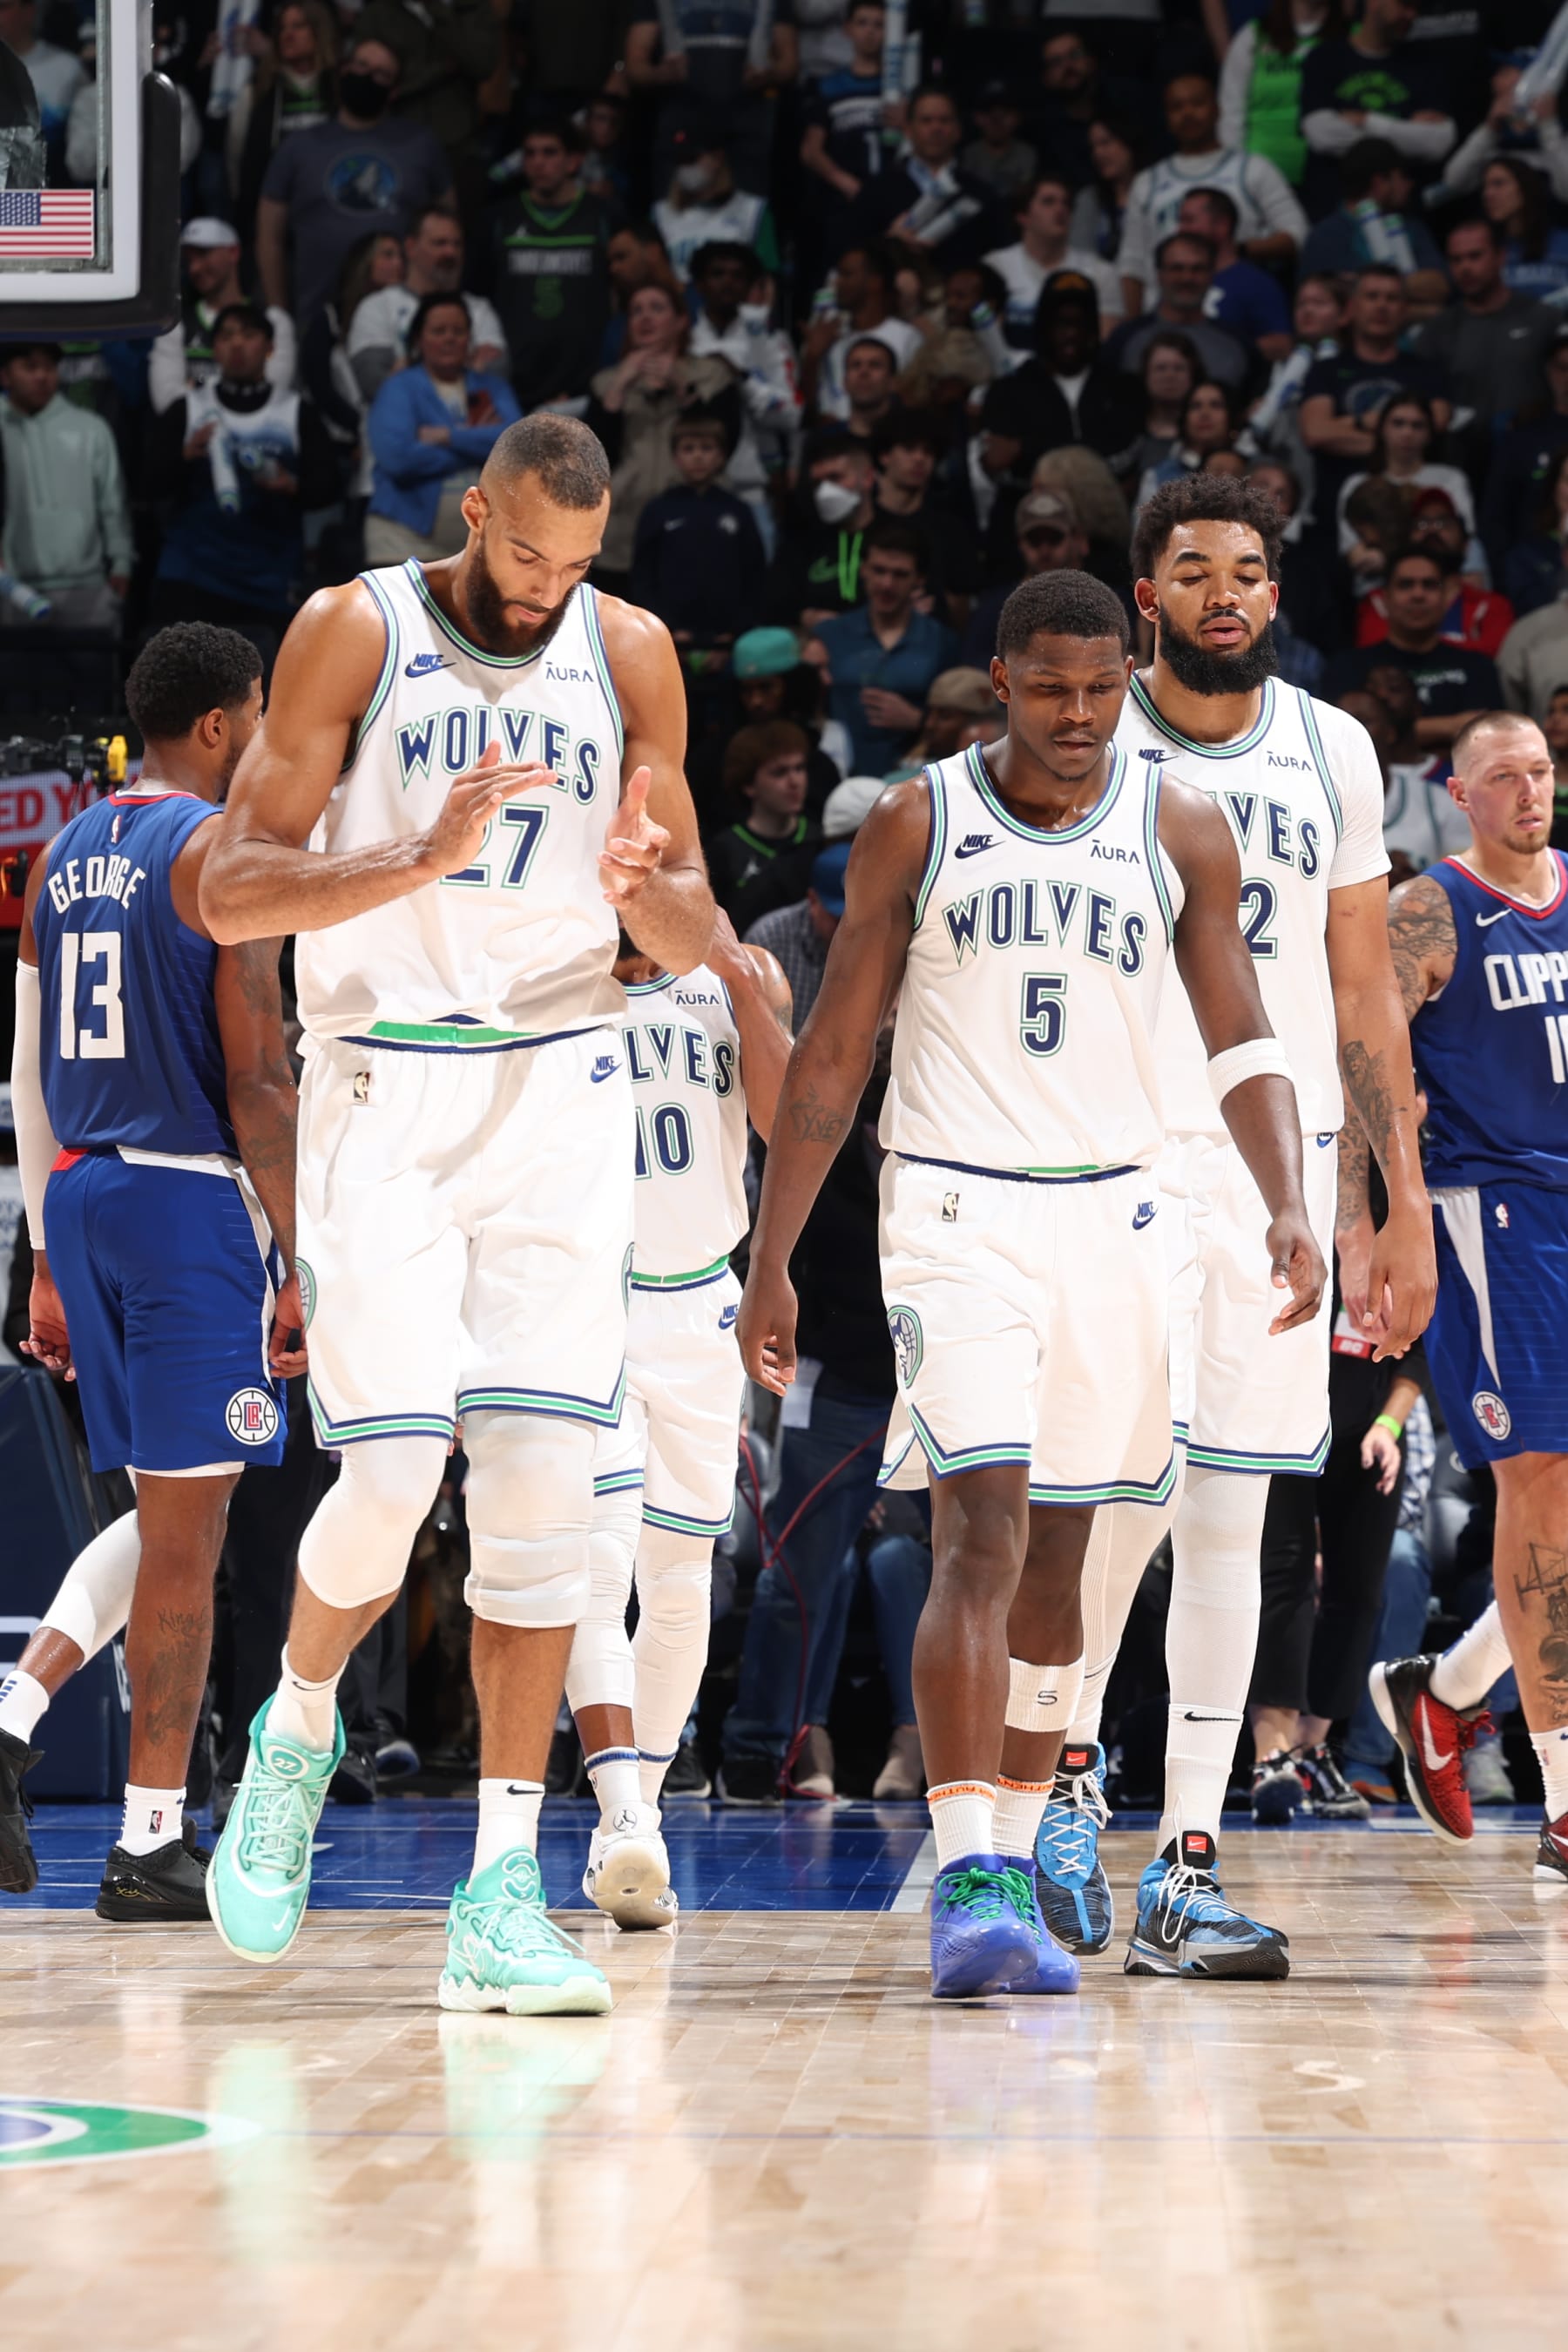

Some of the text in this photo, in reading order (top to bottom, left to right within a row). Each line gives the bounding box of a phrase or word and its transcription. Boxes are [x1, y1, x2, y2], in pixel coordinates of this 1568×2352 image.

[0, 788, 43, 833] ED
[962, 835, 993, 848] NIKE
[1213, 791, 1320, 880] VES
[48, 854, 146, 914] GEORGE
[1239, 877, 1278, 959] 2
[942, 879, 1147, 977] WOLVES
[60, 931, 125, 1059] 13
[1020, 972, 1068, 1058] 5
[1484, 952, 1568, 1010] CLIPP
[595, 1055, 614, 1071] NIKE
[622, 1024, 734, 1098] LVES
[1544, 1014, 1568, 1084] 1
